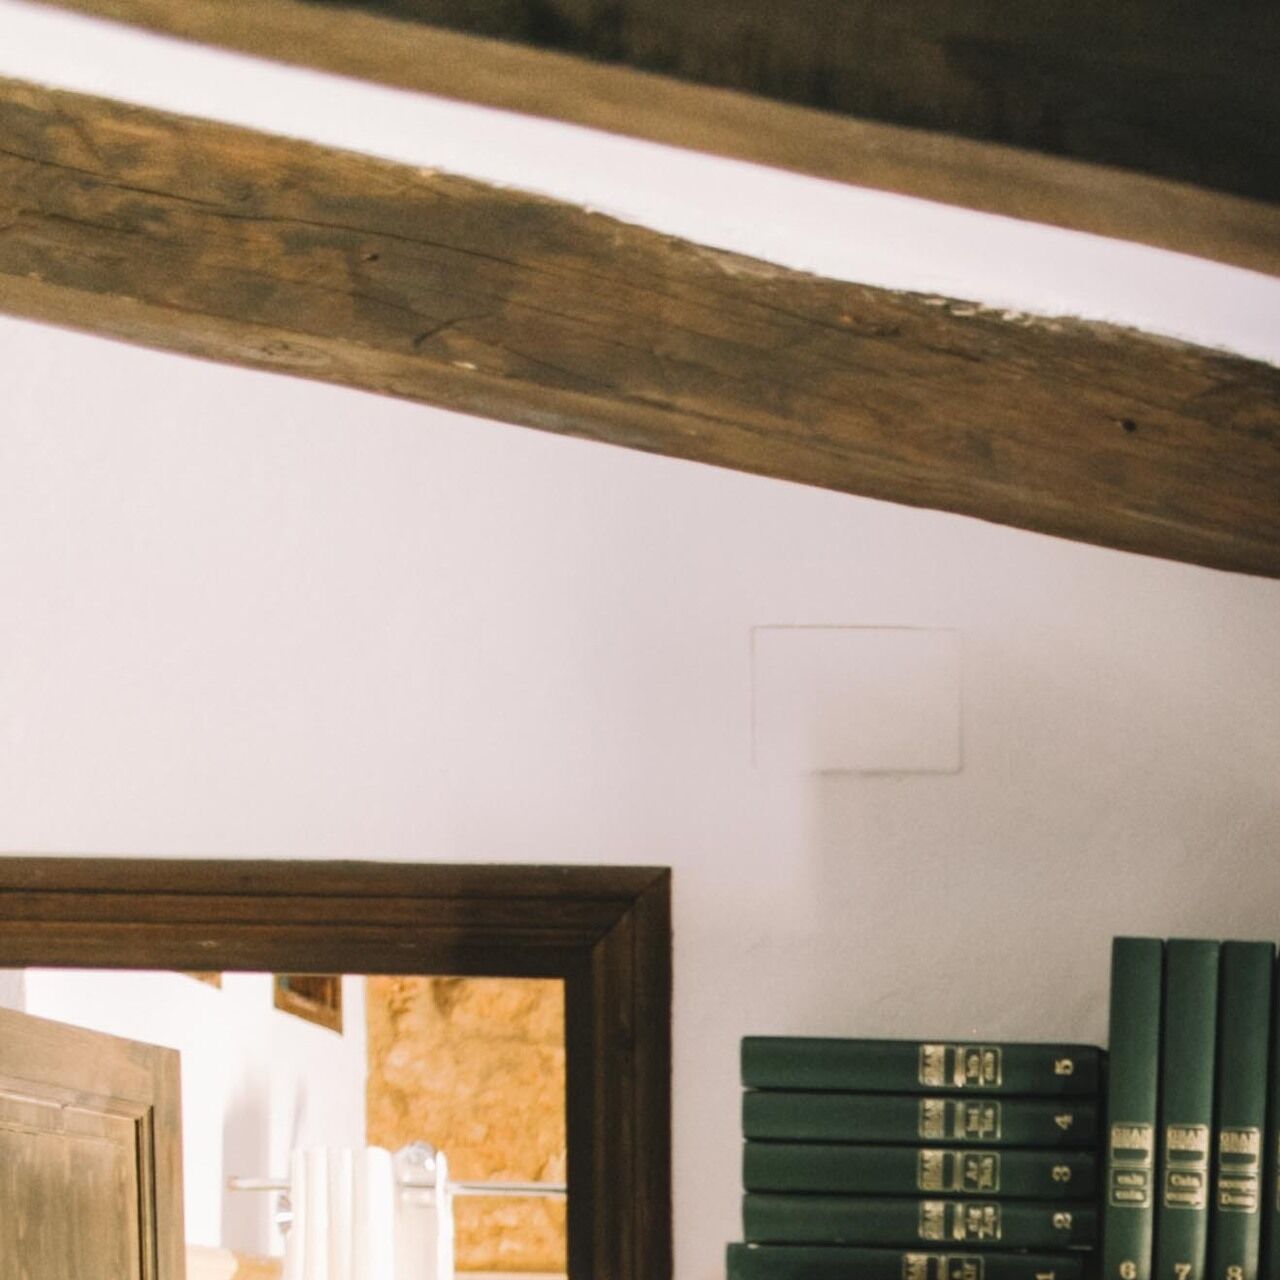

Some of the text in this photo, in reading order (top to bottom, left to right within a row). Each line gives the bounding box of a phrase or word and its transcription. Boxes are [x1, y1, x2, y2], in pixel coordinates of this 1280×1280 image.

[1055, 1059, 1072, 1075] 5
[1055, 1115, 1072, 1130] 4
[1053, 1165, 1070, 1181] 3
[1054, 1212, 1070, 1229] 2
[1119, 1260, 1136, 1280] 6
